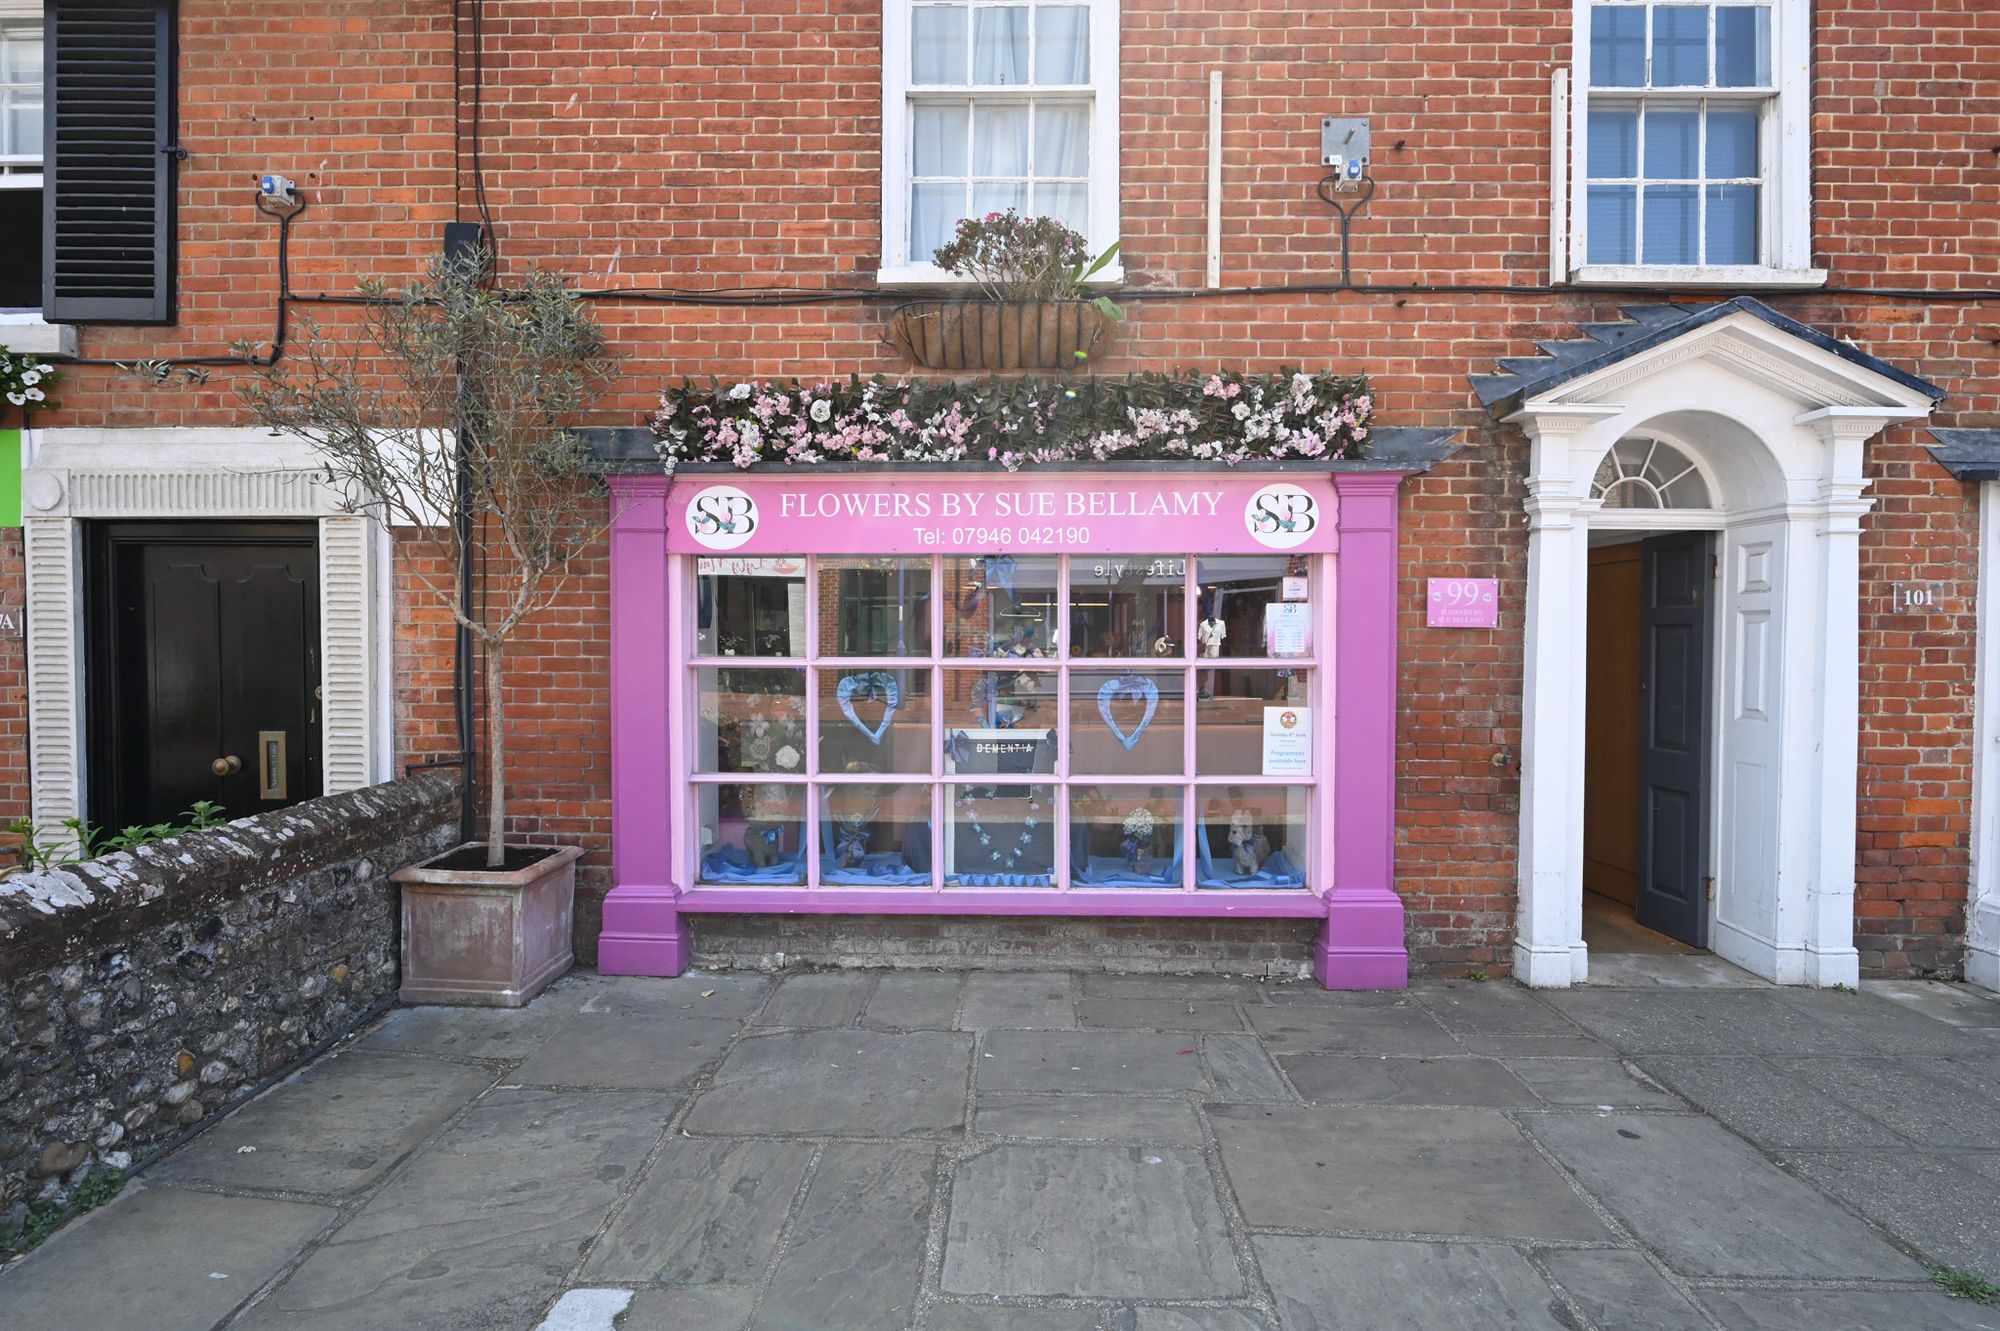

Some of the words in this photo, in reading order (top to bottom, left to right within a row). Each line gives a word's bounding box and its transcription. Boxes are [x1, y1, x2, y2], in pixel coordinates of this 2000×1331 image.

[779, 493, 931, 517] FLOWERS
[941, 493, 985, 517] BY
[995, 492, 1056, 517] SUE
[1065, 491, 1224, 516] BELLAMY
[913, 528, 945, 545] Tel:
[952, 527, 1011, 545] 07946
[1018, 527, 1090, 544] 042190
[1447, 581, 1479, 606] 99
[1904, 590, 1933, 605] 101
[975, 743, 1034, 754] DEMENTIA
